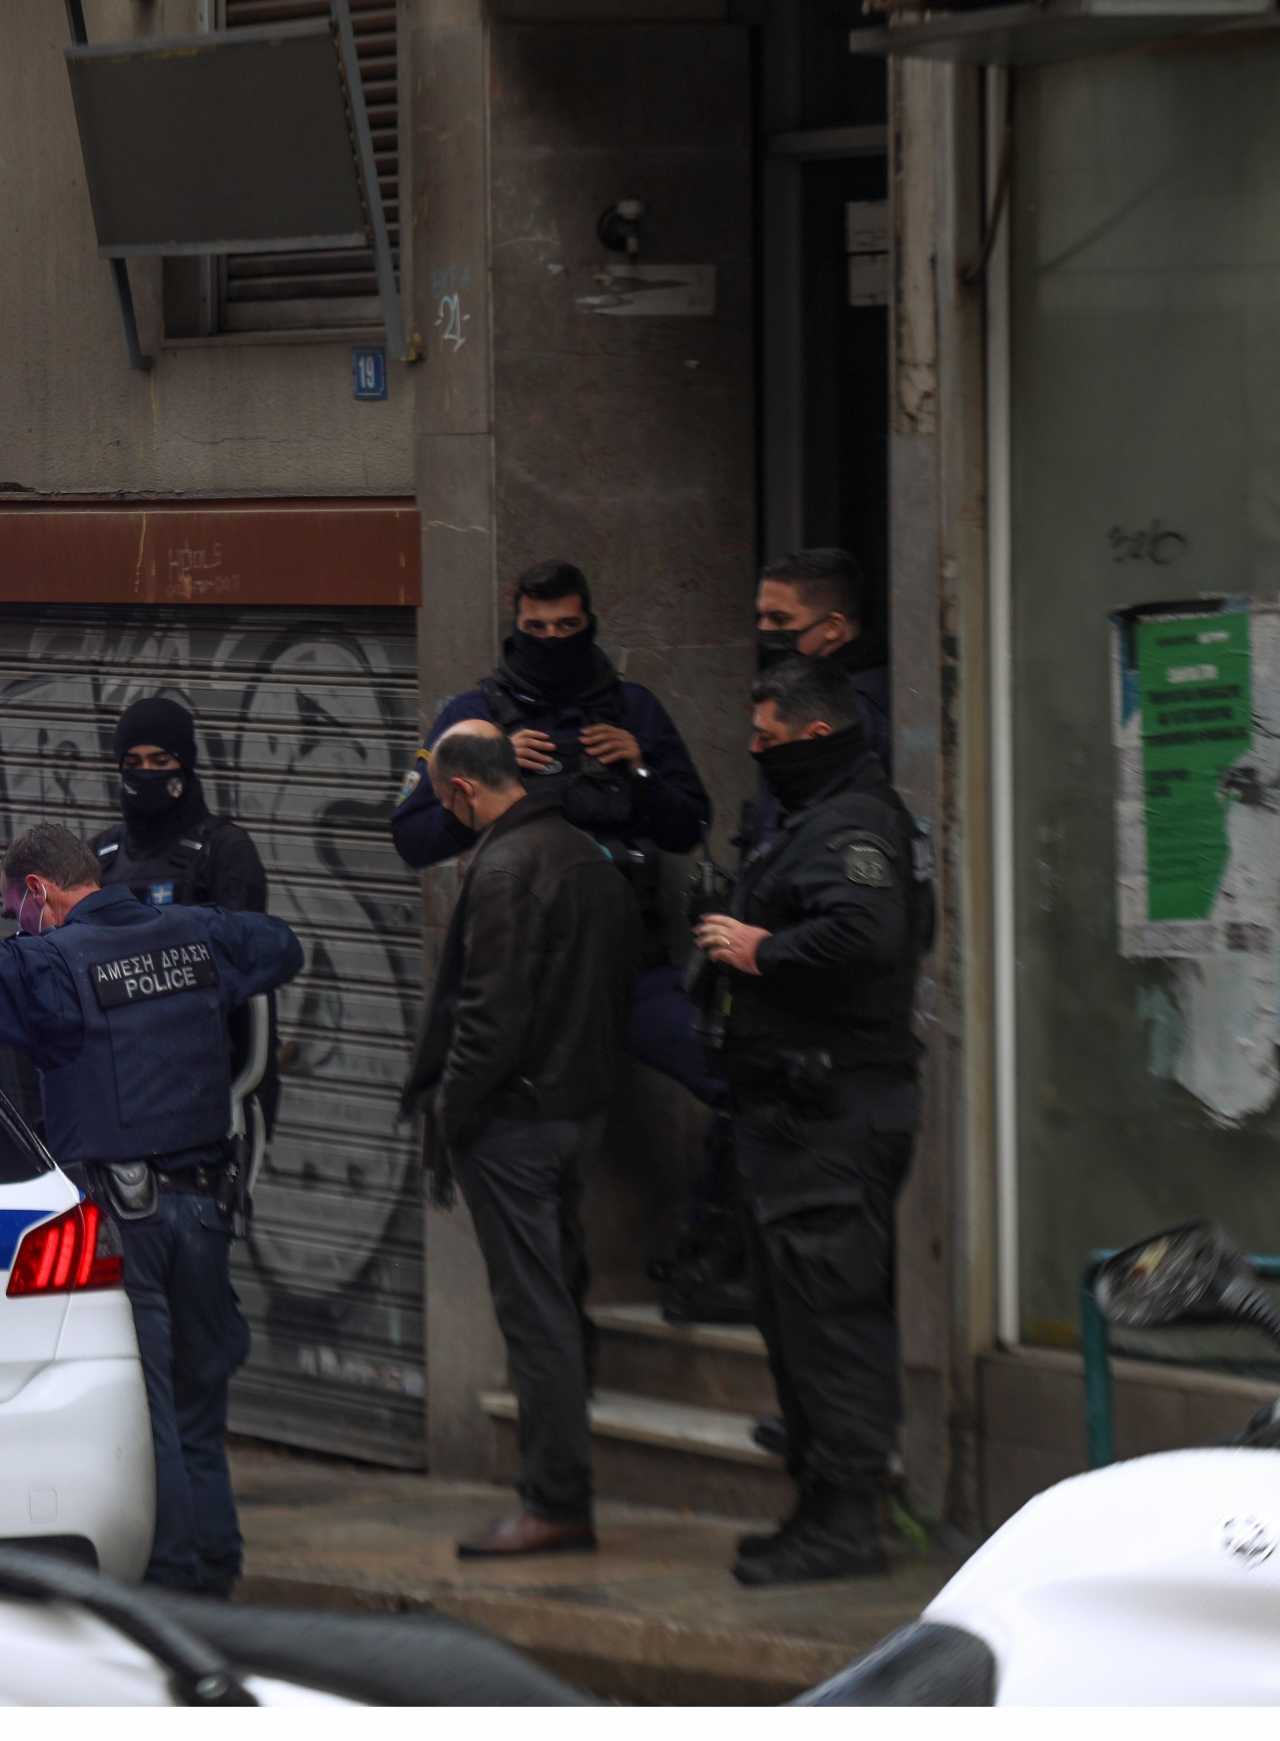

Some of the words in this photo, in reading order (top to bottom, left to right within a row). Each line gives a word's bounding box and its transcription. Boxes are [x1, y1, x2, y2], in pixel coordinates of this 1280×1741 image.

[358, 355, 376, 389] 19
[96, 953, 155, 983] ΑΜΕΣΗ
[160, 943, 211, 969] ΔΡΑΣΗ
[124, 966, 197, 999] POLICE
